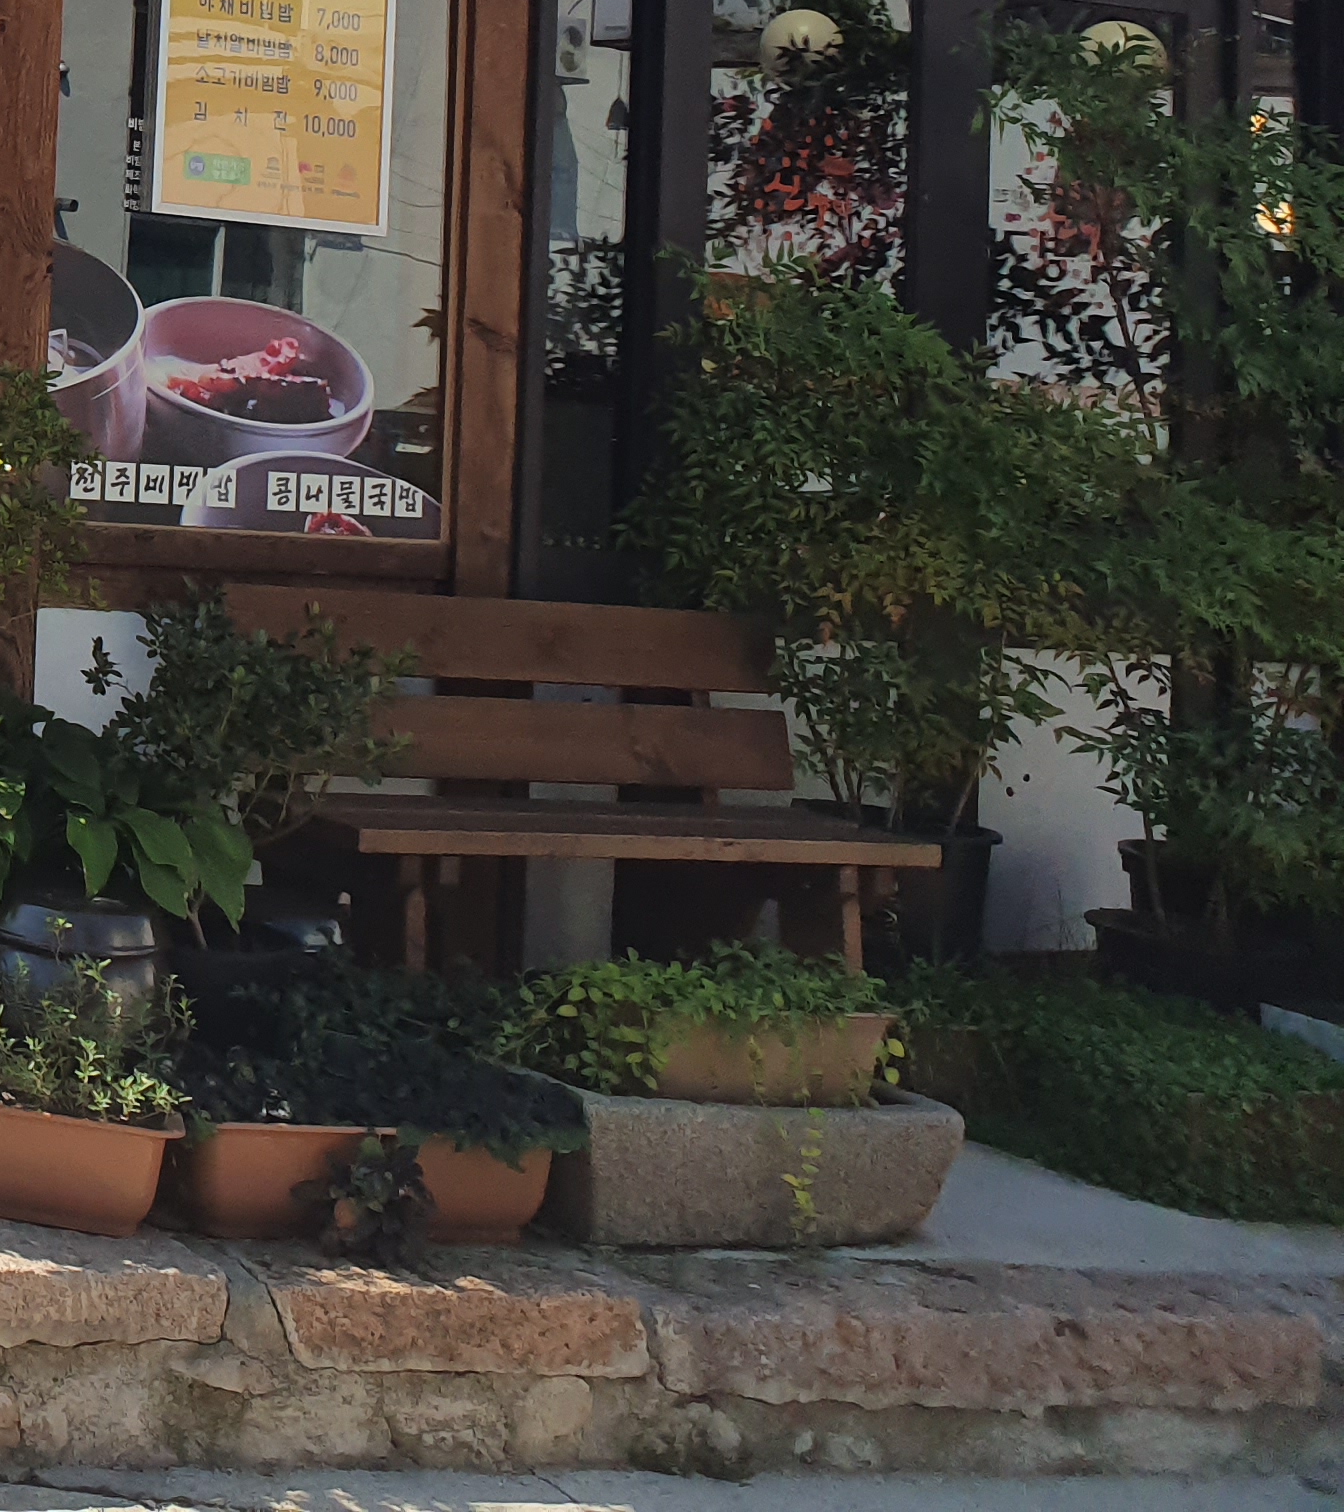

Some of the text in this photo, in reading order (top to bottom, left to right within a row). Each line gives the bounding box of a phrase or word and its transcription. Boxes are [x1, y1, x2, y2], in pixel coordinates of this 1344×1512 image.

[317, 8, 361, 32] 7,000
[315, 44, 359, 67] 8,000
[195, 66, 358, 102] 소고기비빔밥 9,000
[303, 114, 356, 138] 10,000
[272, 476, 417, 512] 콩나물국밥
